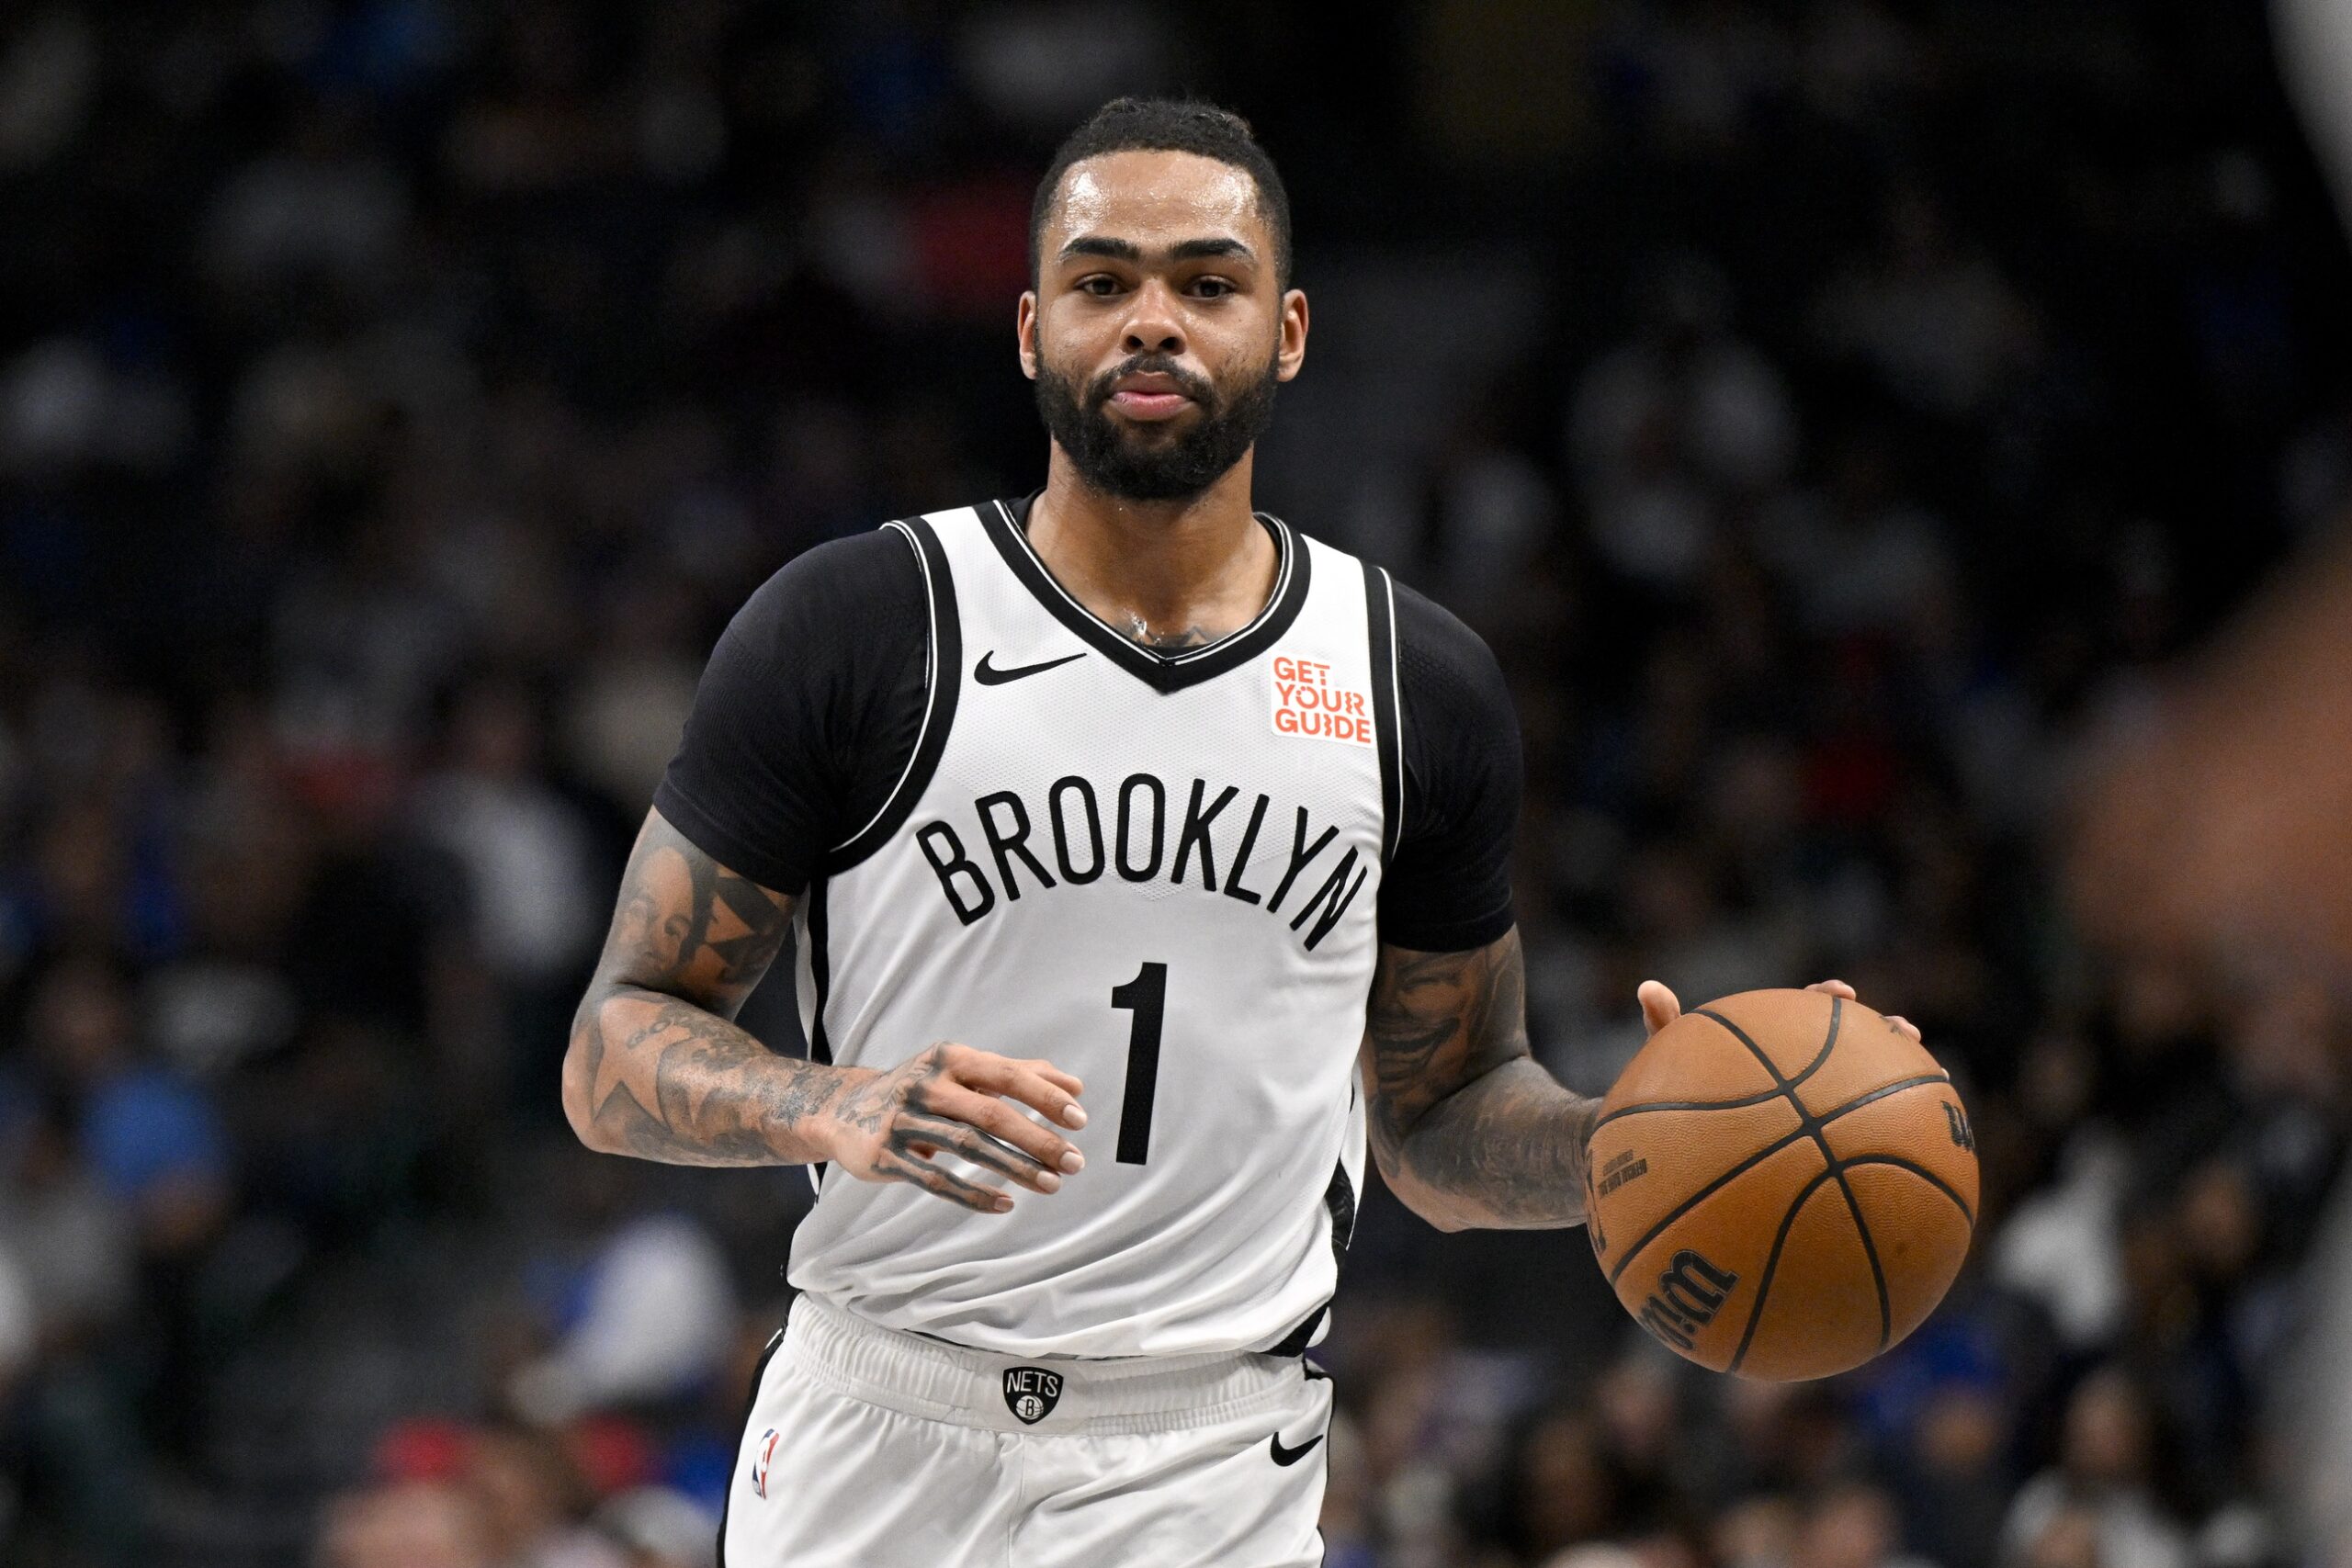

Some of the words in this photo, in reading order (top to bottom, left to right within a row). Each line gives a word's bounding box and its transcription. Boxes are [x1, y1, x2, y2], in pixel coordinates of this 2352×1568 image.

[1273, 657, 1330, 686] GET
[1275, 682, 1366, 716] YOUR
[1275, 708, 1372, 744] GUIDE
[915, 773, 1368, 953] BROOKLYN
[1111, 962, 1168, 1166] 1
[1006, 1371, 1058, 1397] NETS
[1024, 1398, 1035, 1416] B
